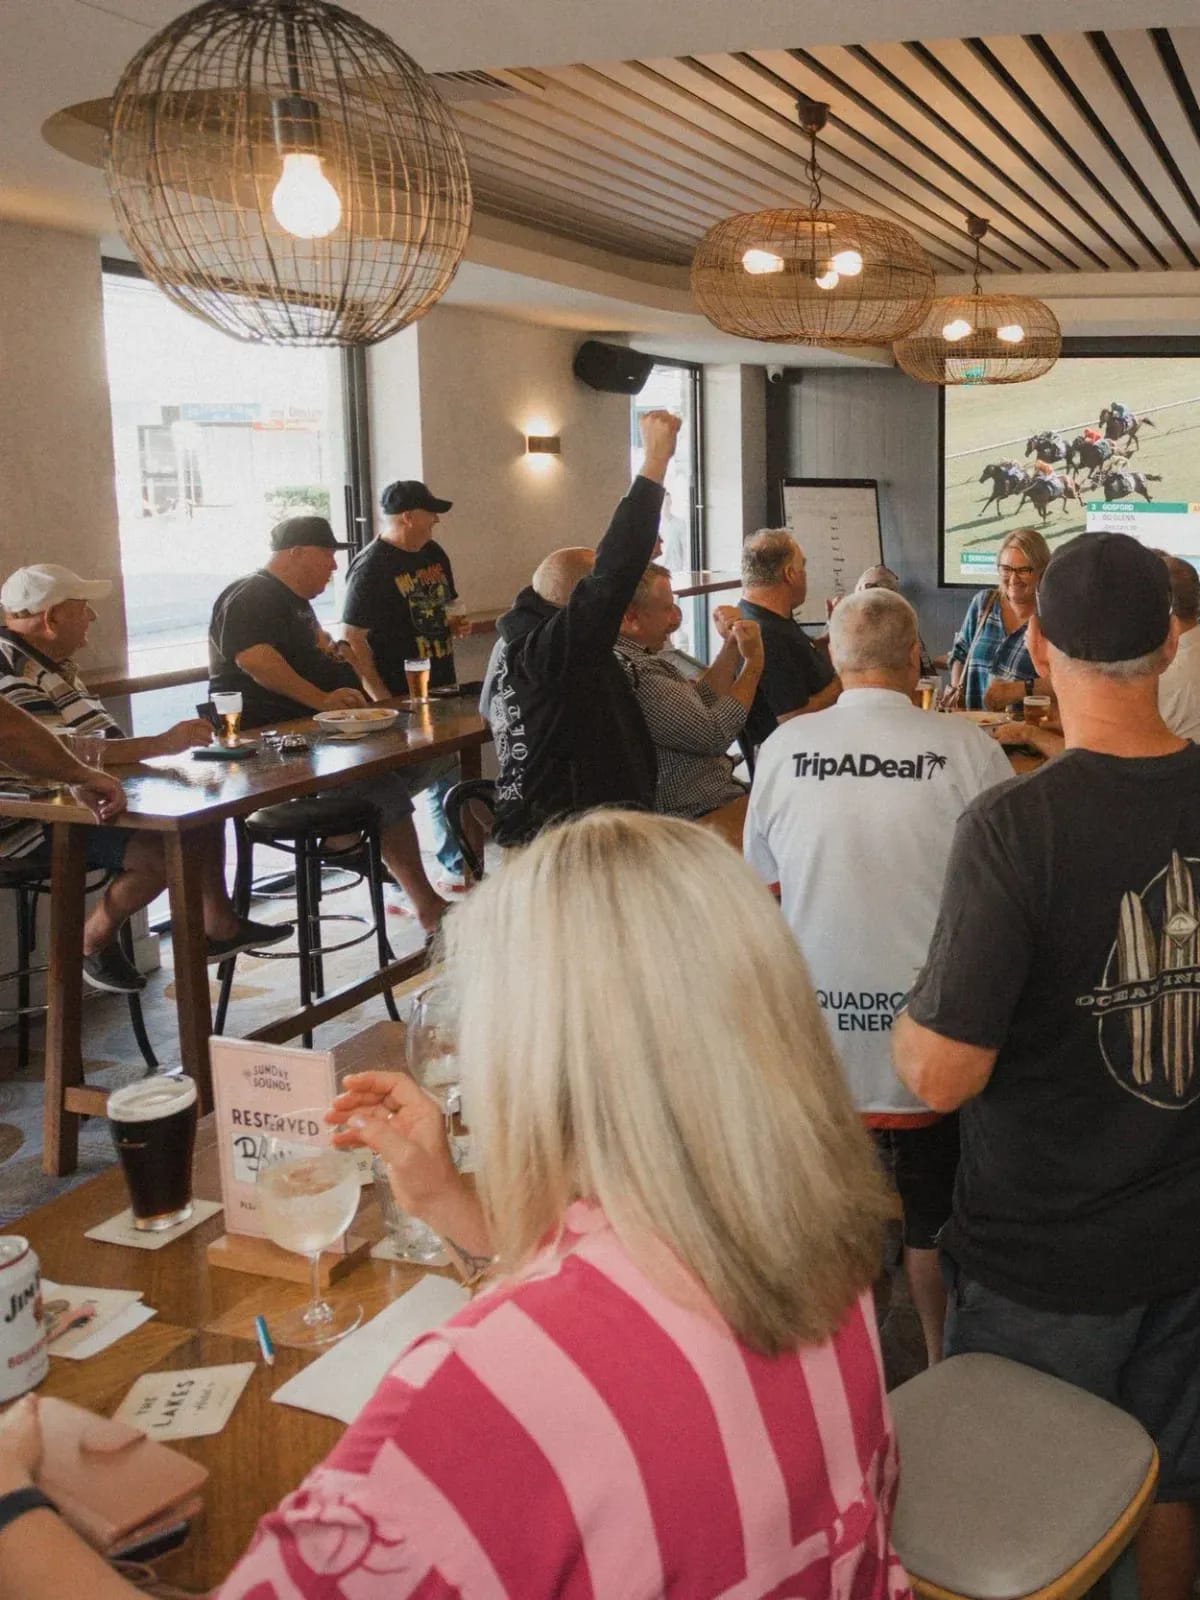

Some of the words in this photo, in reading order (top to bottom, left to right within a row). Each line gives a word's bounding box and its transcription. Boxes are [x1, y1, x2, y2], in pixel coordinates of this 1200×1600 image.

[1102, 503, 1134, 511] GOSFORD
[792, 752, 924, 781] TripADeal
[253, 1065, 289, 1080] SUNDAY
[253, 1076, 291, 1092] SOUNDS
[231, 1108, 320, 1137] RESERVED
[5, 1285, 36, 1323] JIM
